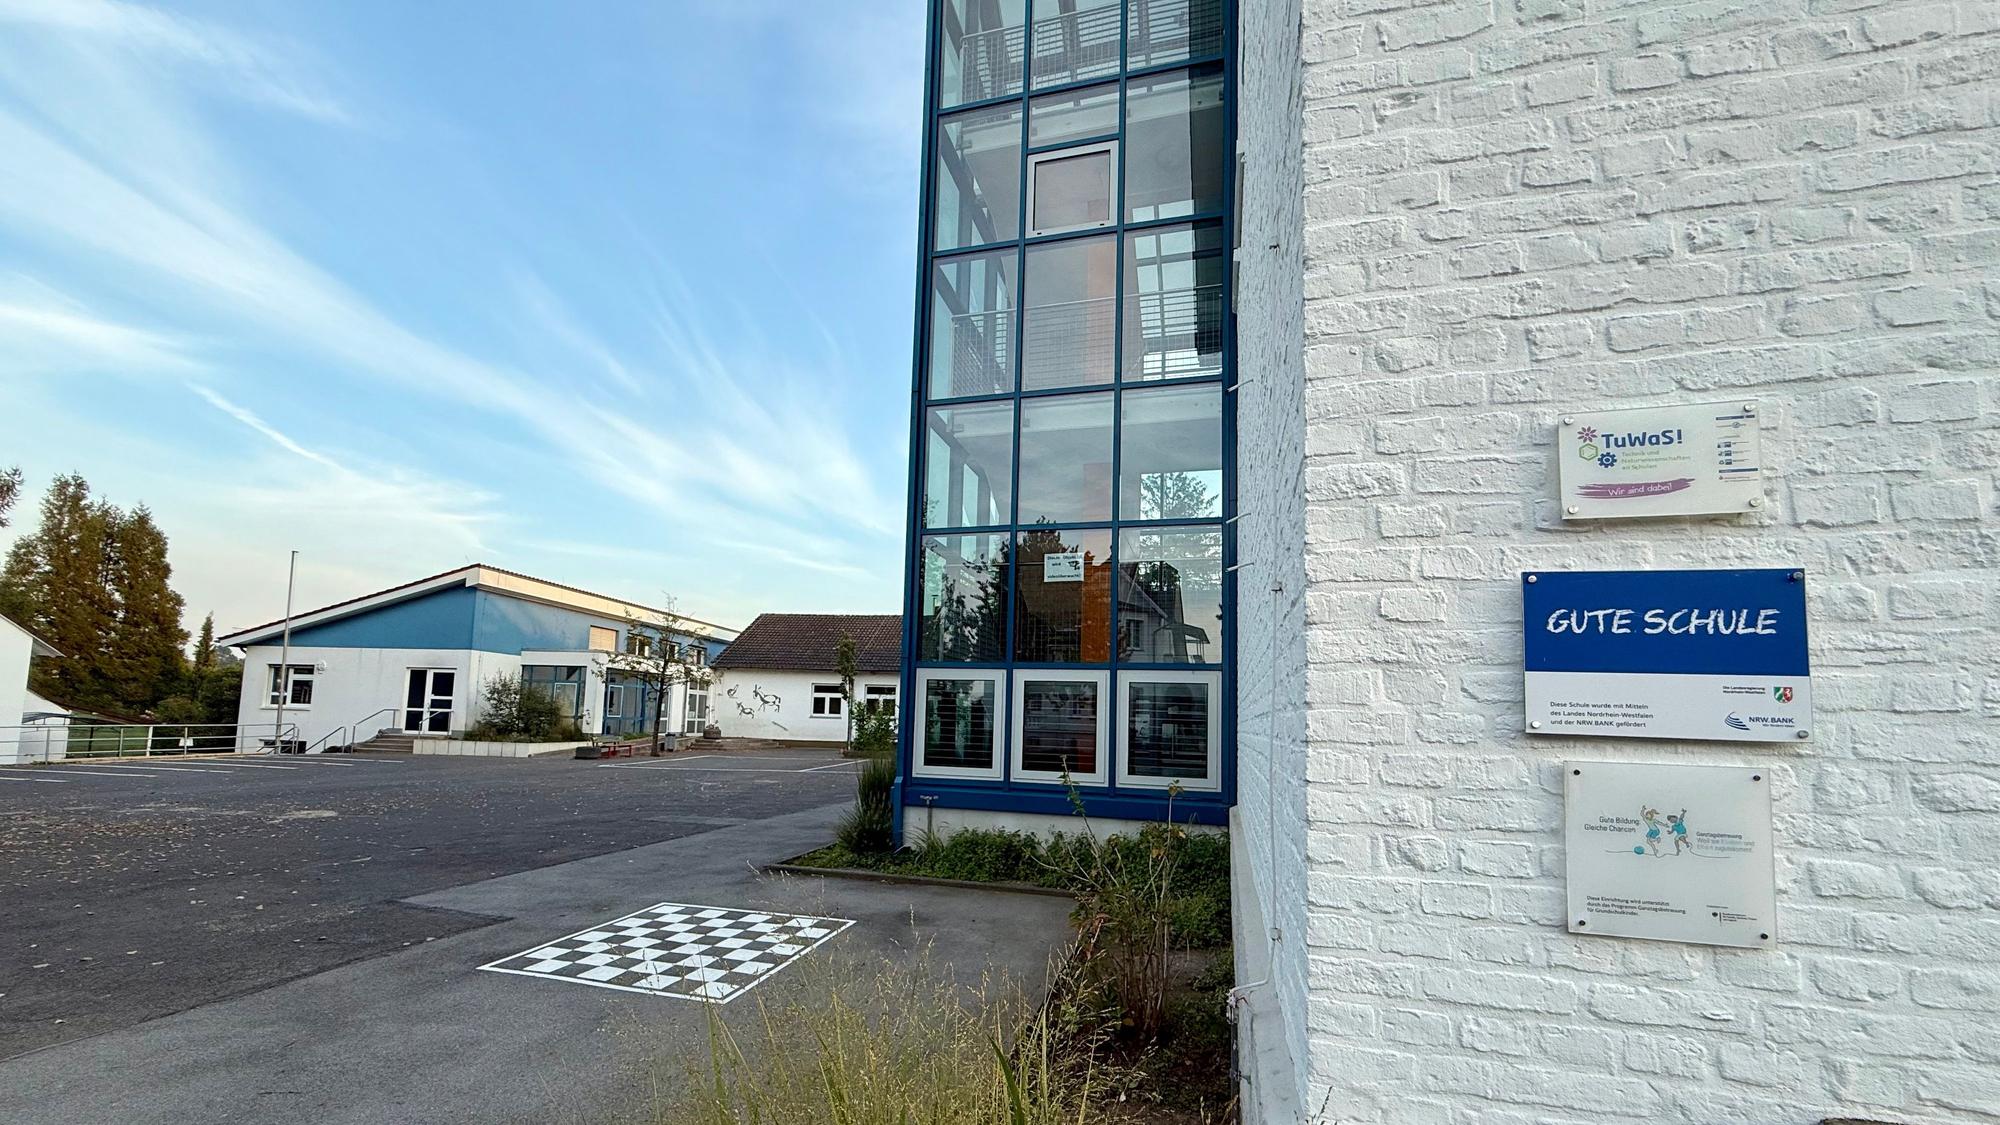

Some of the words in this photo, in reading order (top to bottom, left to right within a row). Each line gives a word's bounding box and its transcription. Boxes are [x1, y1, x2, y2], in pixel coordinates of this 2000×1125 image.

[1601, 428, 1683, 449] TuWaS!
[1607, 487, 1626, 497] Wir
[1628, 485, 1645, 495] sind
[1647, 482, 1673, 492] dabei!
[1546, 608, 1636, 635] GUTE
[1643, 608, 1781, 635] SCHULE
[1569, 701, 1590, 709] Schule
[1587, 711, 1654, 719] Nordrhein-Westfalen
[1615, 721, 1647, 729] gefördert
[1599, 815, 1615, 823] Gute
[1584, 823, 1608, 832] Gleiche
